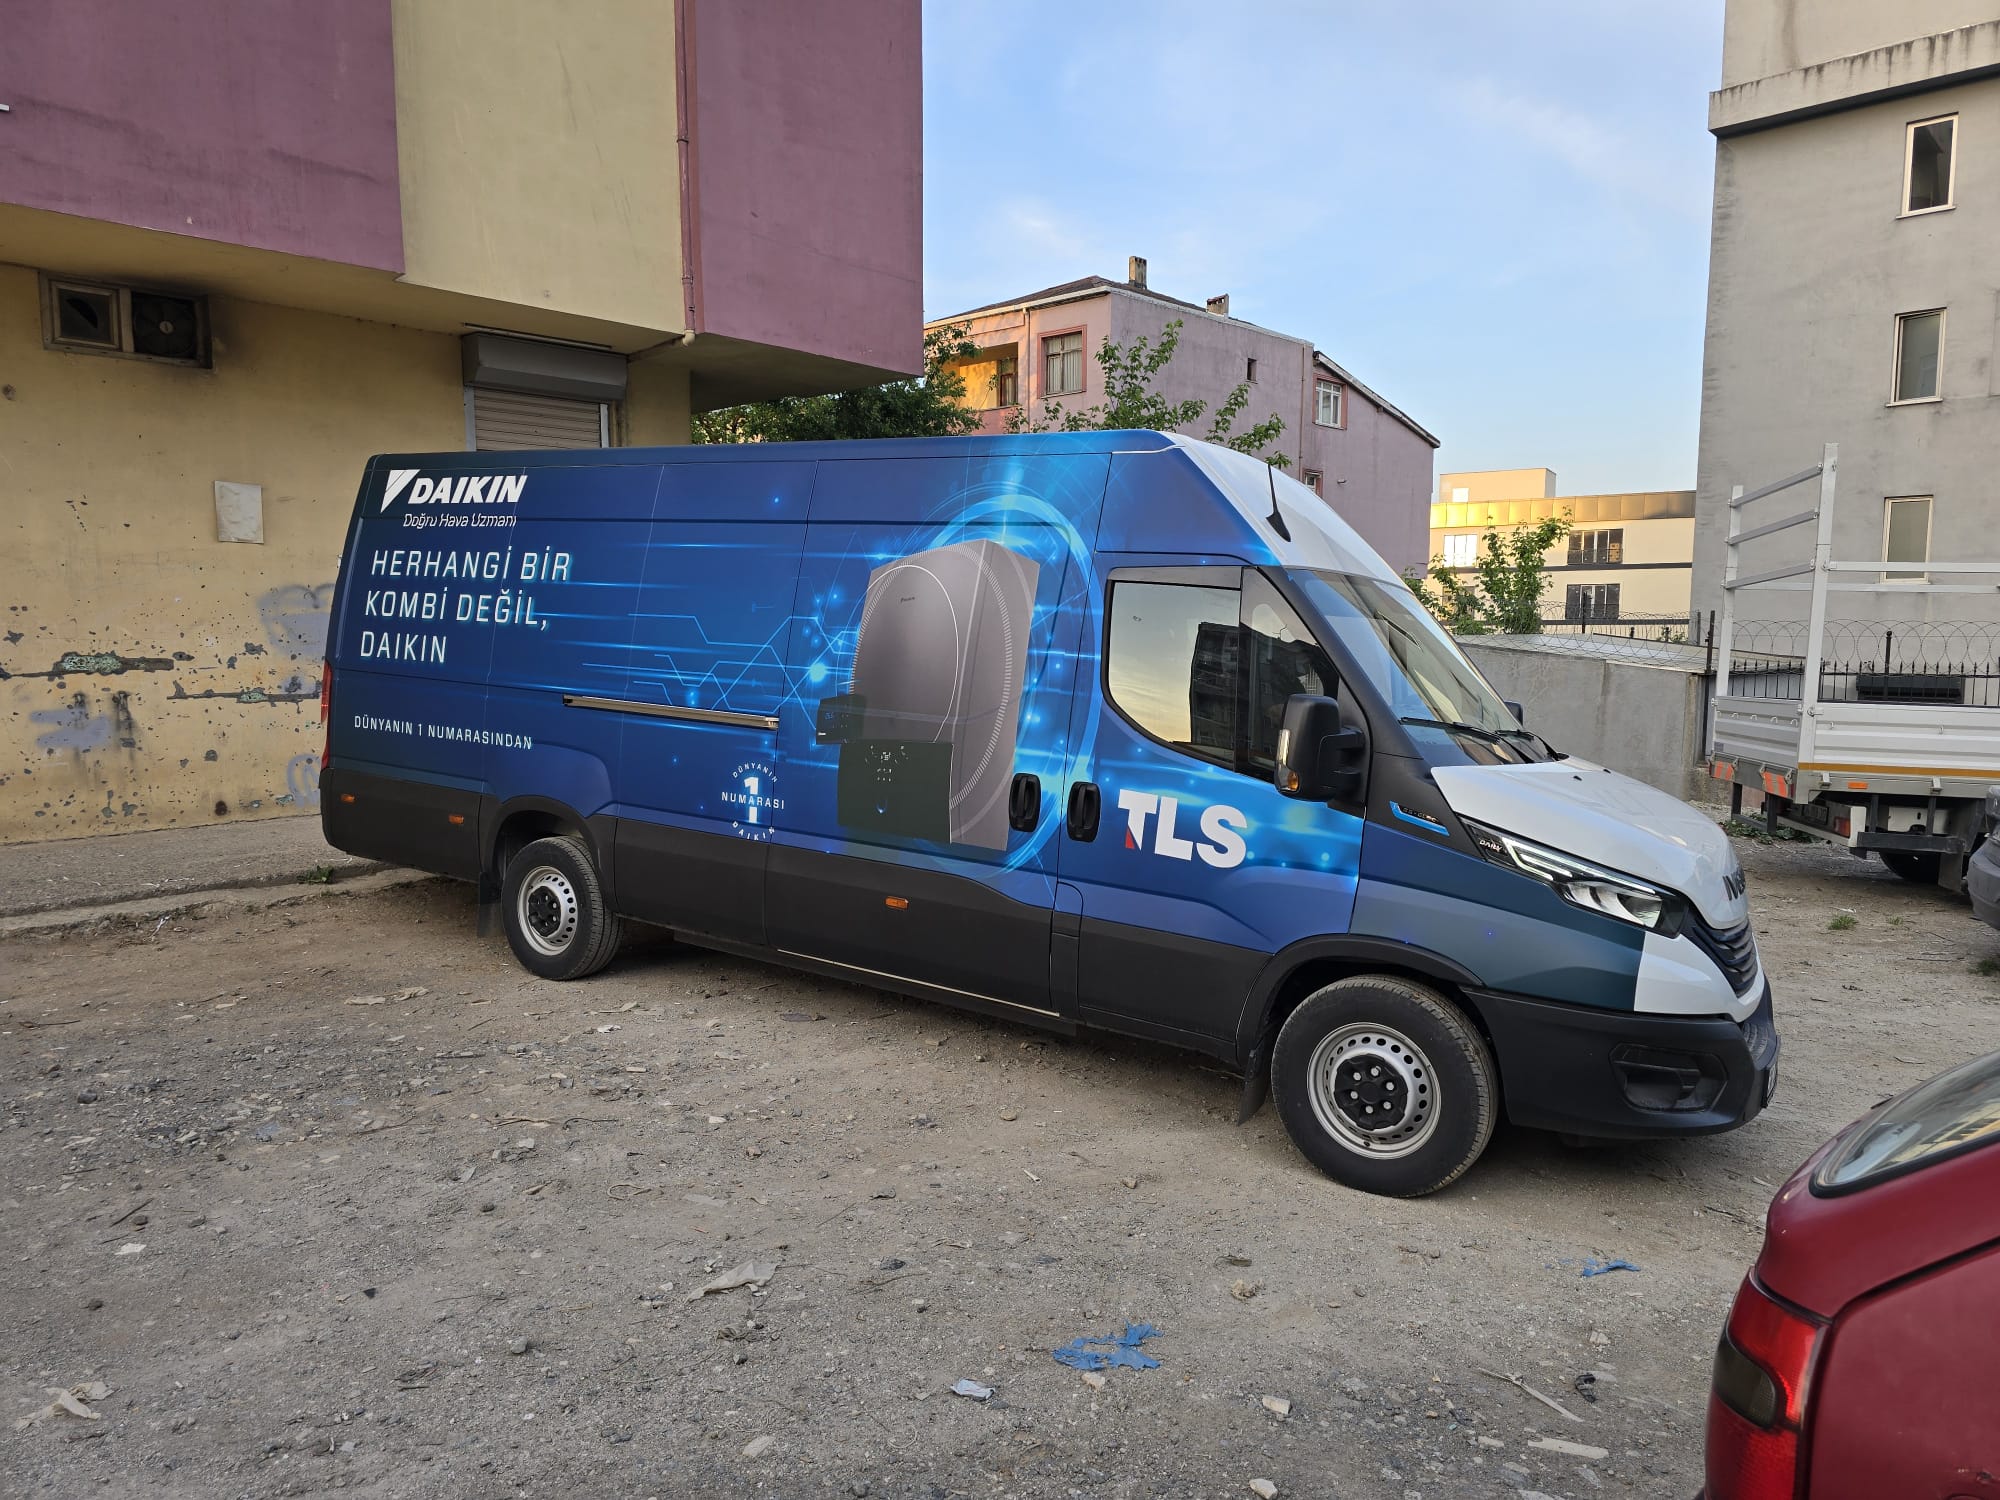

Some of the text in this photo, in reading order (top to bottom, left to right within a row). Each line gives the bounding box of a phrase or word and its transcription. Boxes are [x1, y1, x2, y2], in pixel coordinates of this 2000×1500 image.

[407, 474, 528, 505] DAIKIN
[403, 513, 517, 530] Doğru Hava Uzmanı
[371, 546, 571, 581] HERHANGİ BİR
[364, 587, 548, 630] KOMBİ DEĞİL,
[360, 630, 447, 664] DAIKIN
[354, 713, 532, 750] DÜNYANIN 1 NUMARASINDAN
[732, 762, 778, 783] DÜNYANIN
[721, 791, 785, 810] NUMARASI
[744, 776, 759, 824] 1
[732, 820, 775, 841] DAIKIN
[1117, 788, 1248, 869] TLS
